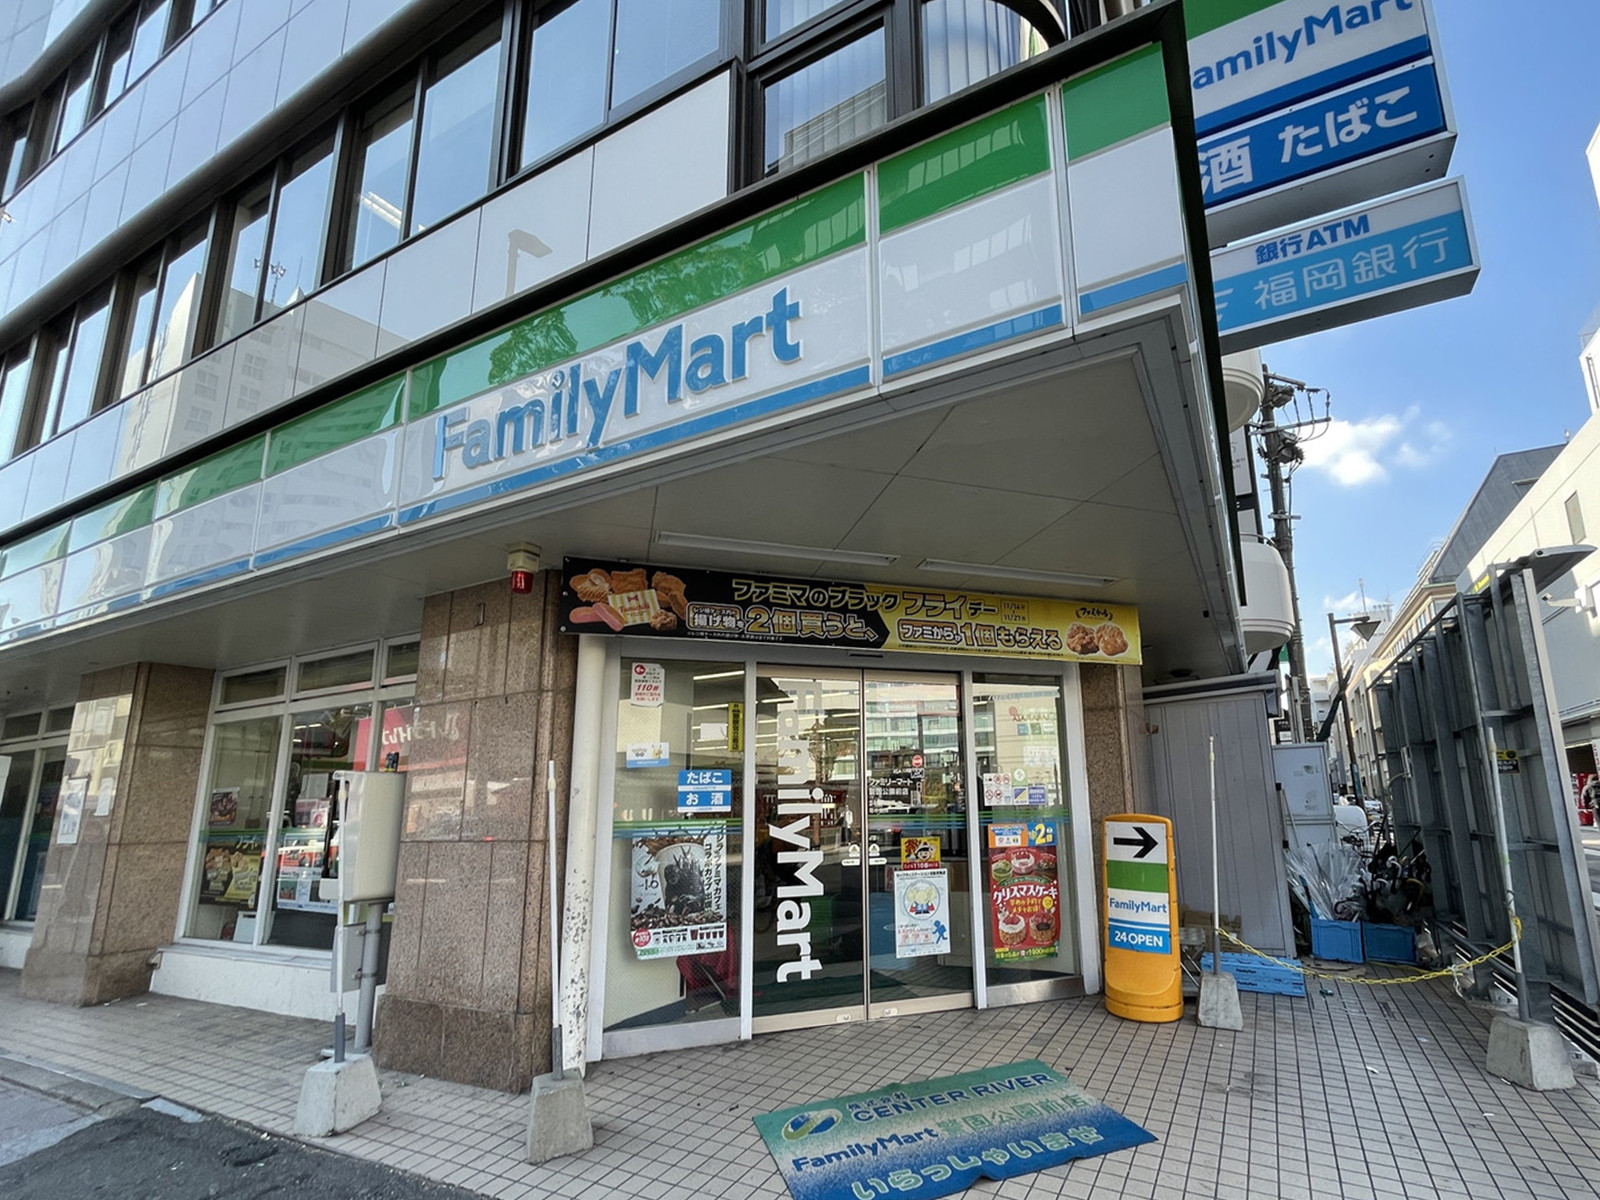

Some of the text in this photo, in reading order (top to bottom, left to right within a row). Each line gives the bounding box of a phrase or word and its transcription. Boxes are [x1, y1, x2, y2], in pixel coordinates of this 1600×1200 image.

[1192, 0, 1412, 90] amilyMar
[1198, 86, 1417, 195] 酒 たばこ
[1255, 214, 1370, 265] 銀行ATM
[1254, 227, 1449, 310] 福岡銀行
[433, 286, 802, 480] FamilyMart
[686, 771, 724, 785] たばこ
[868, 777, 914, 786] ファミリーマート
[769, 680, 824, 983] FamilyMart
[993, 885, 1058, 905] クリスマスケーキ
[1109, 898, 1168, 913] FamilyMart
[852, 1073, 1054, 1123] CENTER RIVER
[792, 1127, 939, 1172] FamilyMart
[852, 1125, 1104, 1200] いらっしゃいませ
